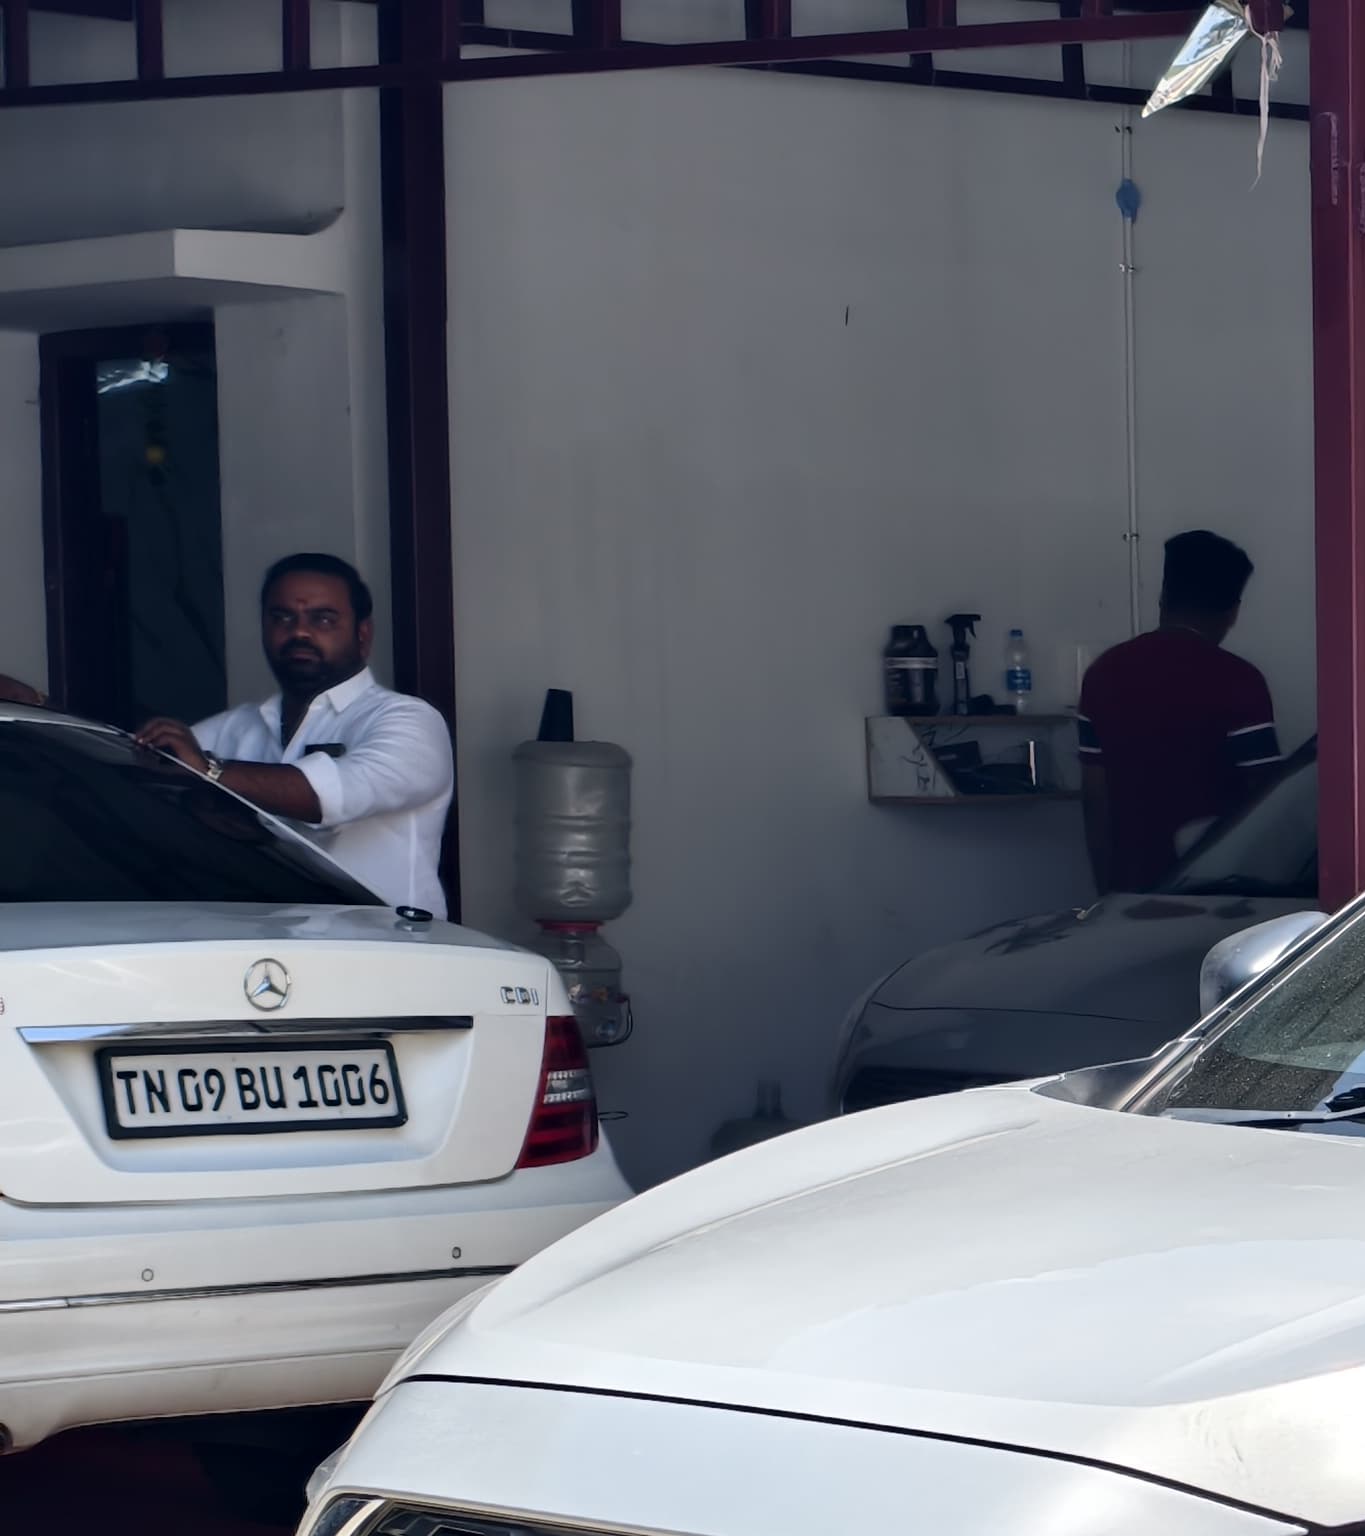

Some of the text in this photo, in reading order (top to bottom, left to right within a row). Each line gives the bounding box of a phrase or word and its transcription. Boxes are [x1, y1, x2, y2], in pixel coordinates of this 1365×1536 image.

[501, 986, 539, 1005] CDI
[116, 1063, 390, 1114] TN 09 BU 1006
